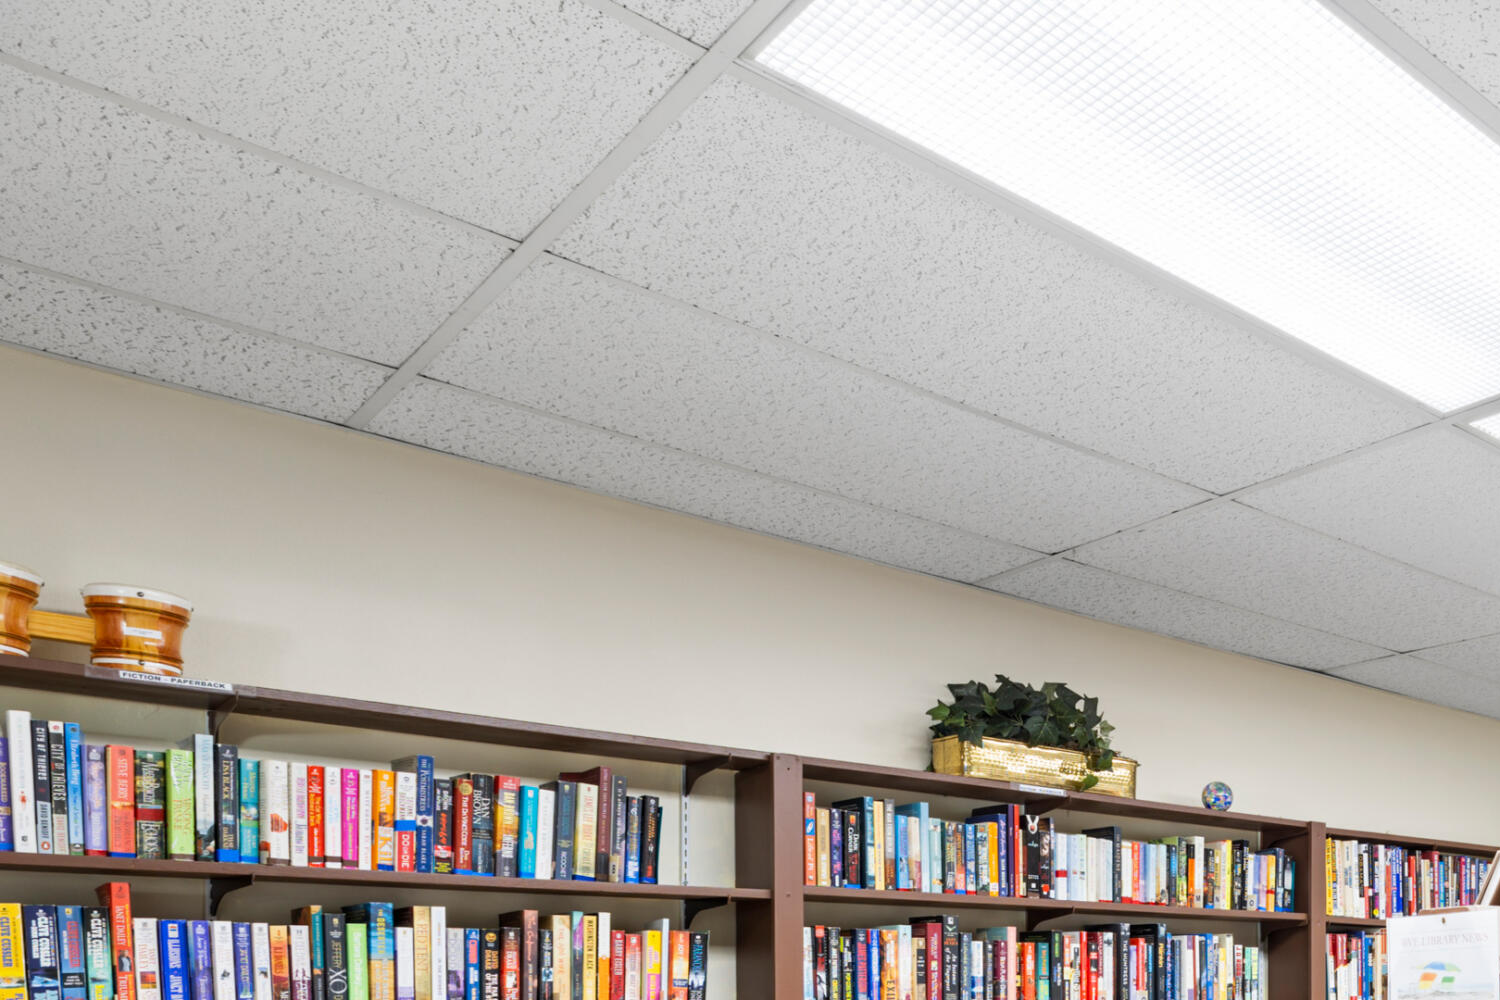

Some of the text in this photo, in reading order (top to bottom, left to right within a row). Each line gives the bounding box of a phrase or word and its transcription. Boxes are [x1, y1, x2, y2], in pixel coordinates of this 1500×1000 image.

[122, 672, 160, 681] FICTION
[52, 744, 62, 759] CITY
[38, 755, 47, 780] THIEVES
[53, 772, 65, 801] THIEVES
[223, 776, 232, 800] BLACK
[473, 790, 481, 825] BROWN
[481, 798, 491, 818] DAN
[1, 938, 12, 968] CUSSLER
[38, 917, 51, 967] CLIVE CUSSLER
[90, 919, 106, 968] CLIVE CUSSLER
[332, 940, 342, 969] JEFFERY
